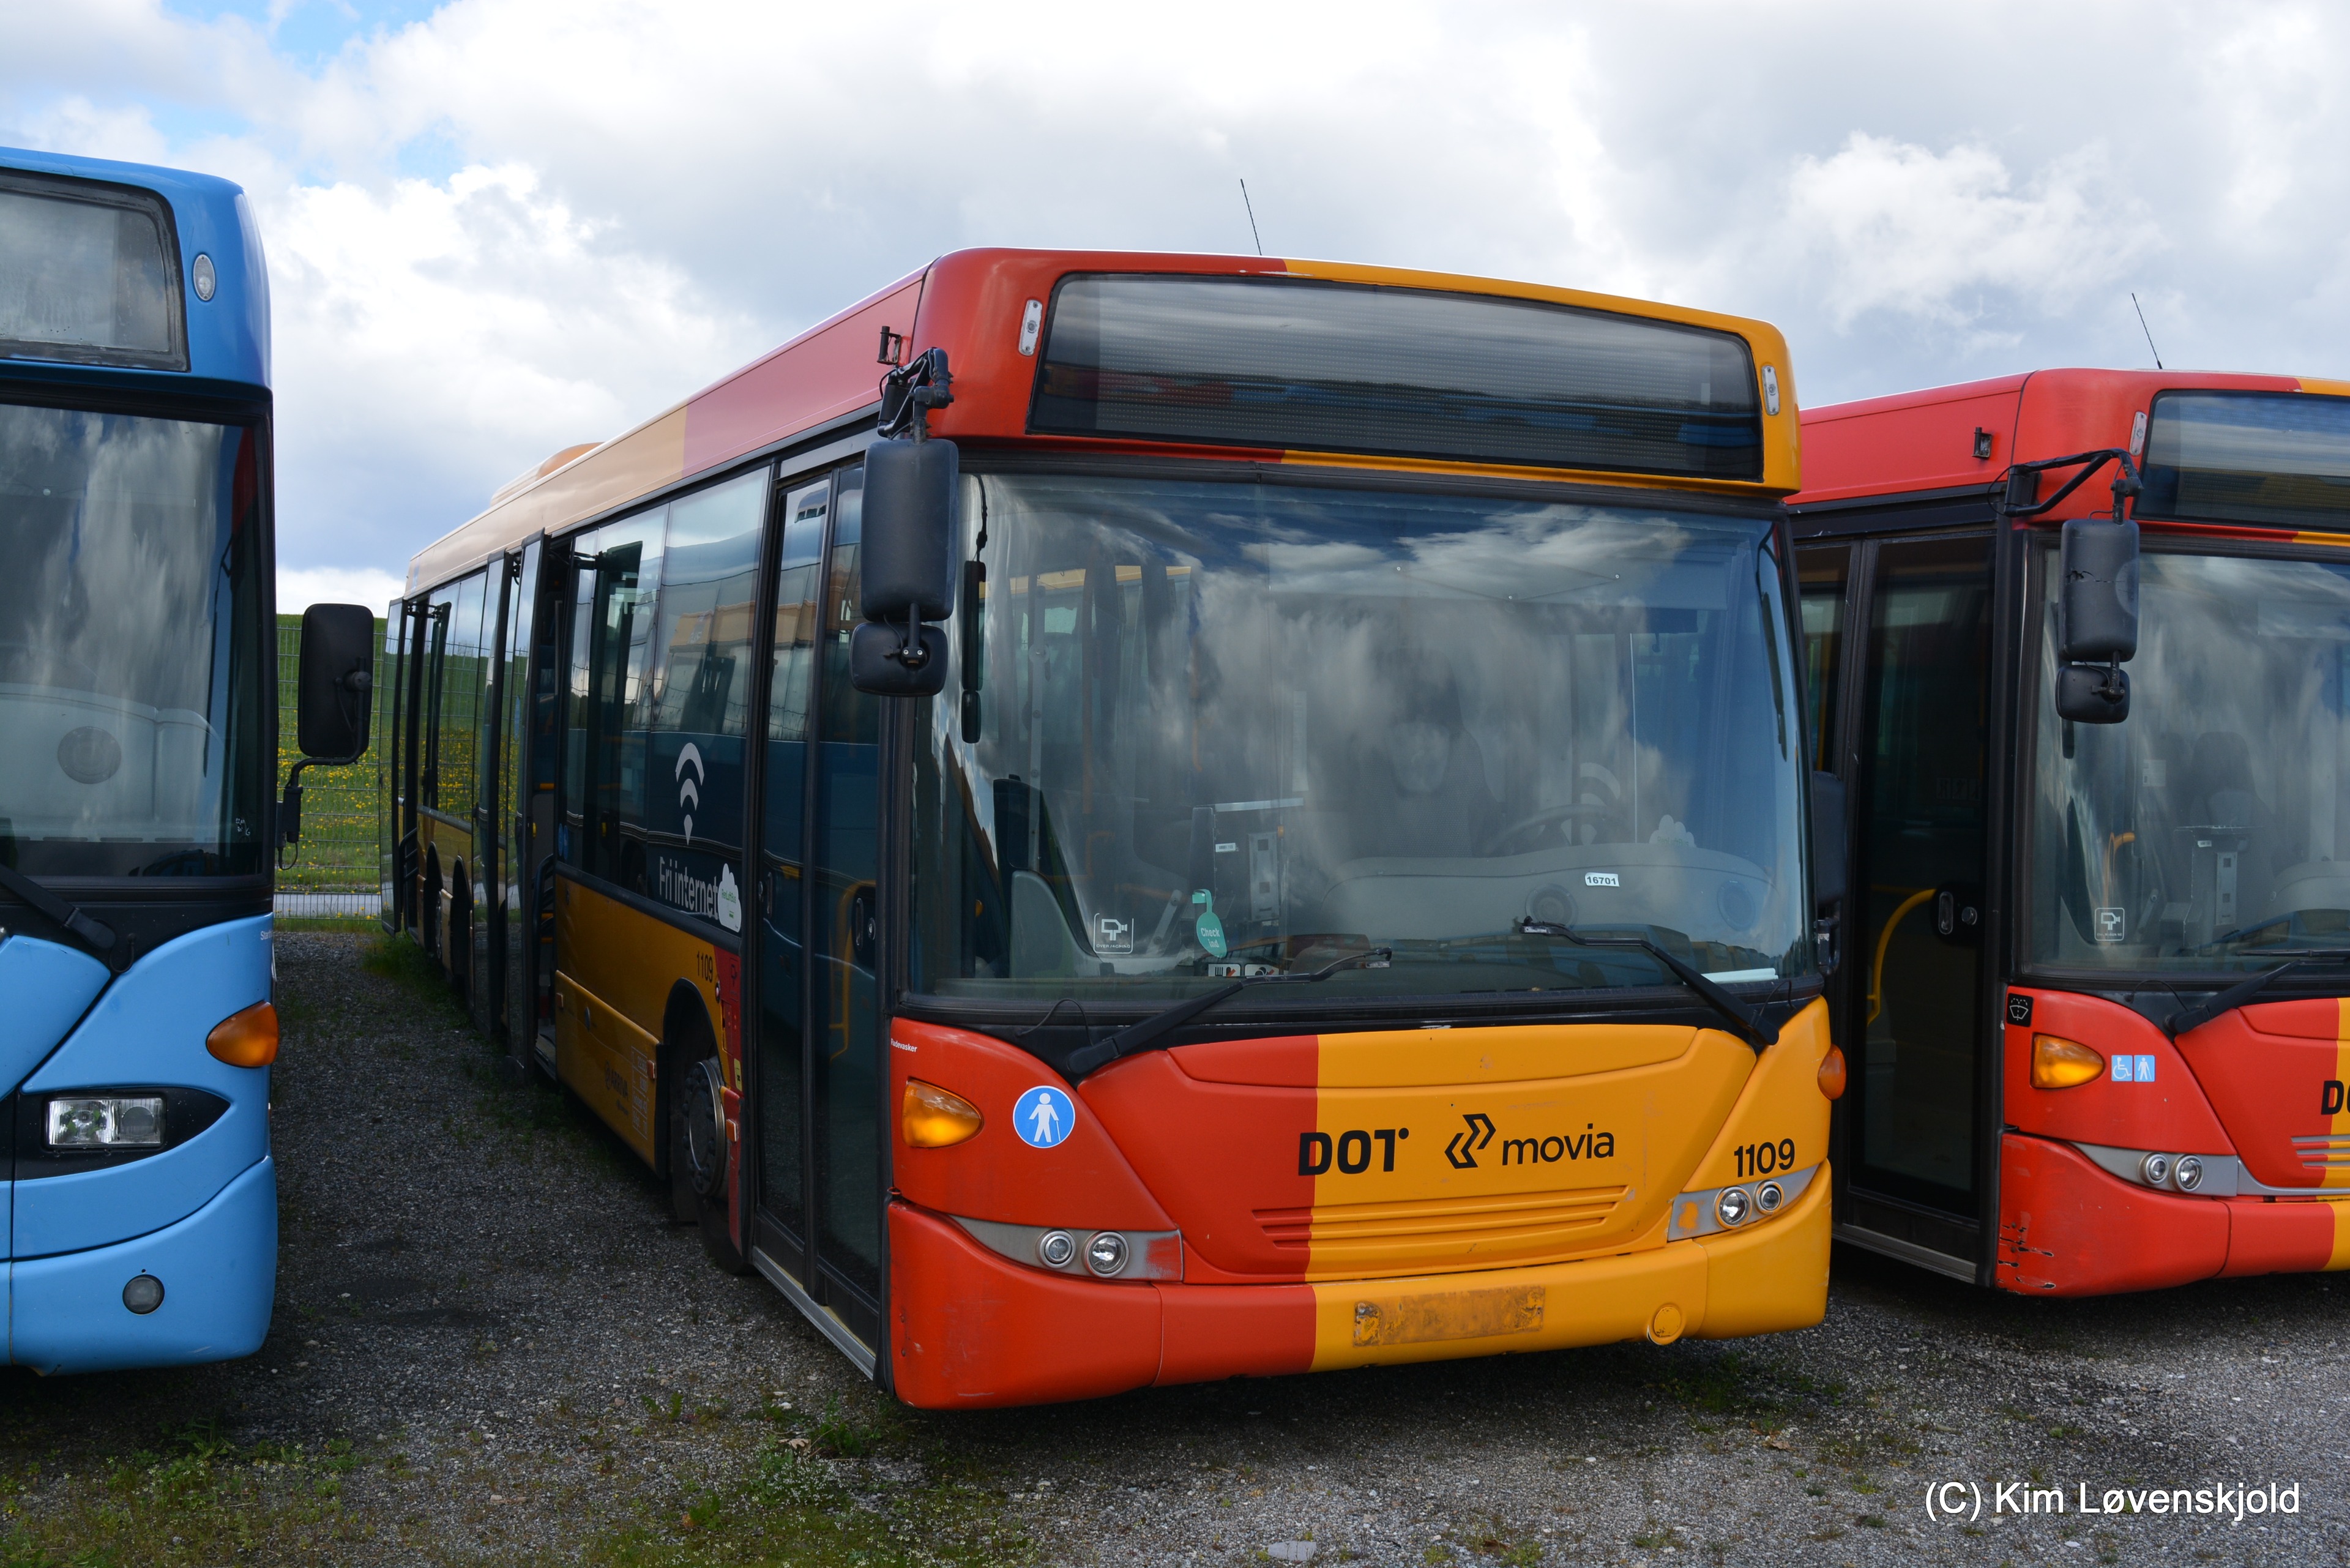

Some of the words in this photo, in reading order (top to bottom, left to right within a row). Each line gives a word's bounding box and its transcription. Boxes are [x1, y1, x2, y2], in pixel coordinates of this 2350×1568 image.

[660, 857, 672, 902] Fri
[675, 861, 718, 920] internet
[1587, 876, 1616, 885] 16701
[1200, 927, 1220, 938] Check
[1207, 939, 1220, 947] ind
[696, 950, 713, 983] 1109
[2321, 1080, 2350, 1115] D
[1299, 1128, 1401, 1176] DOT
[1502, 1123, 1614, 1165] movia
[1734, 1138, 1795, 1178] 1109
